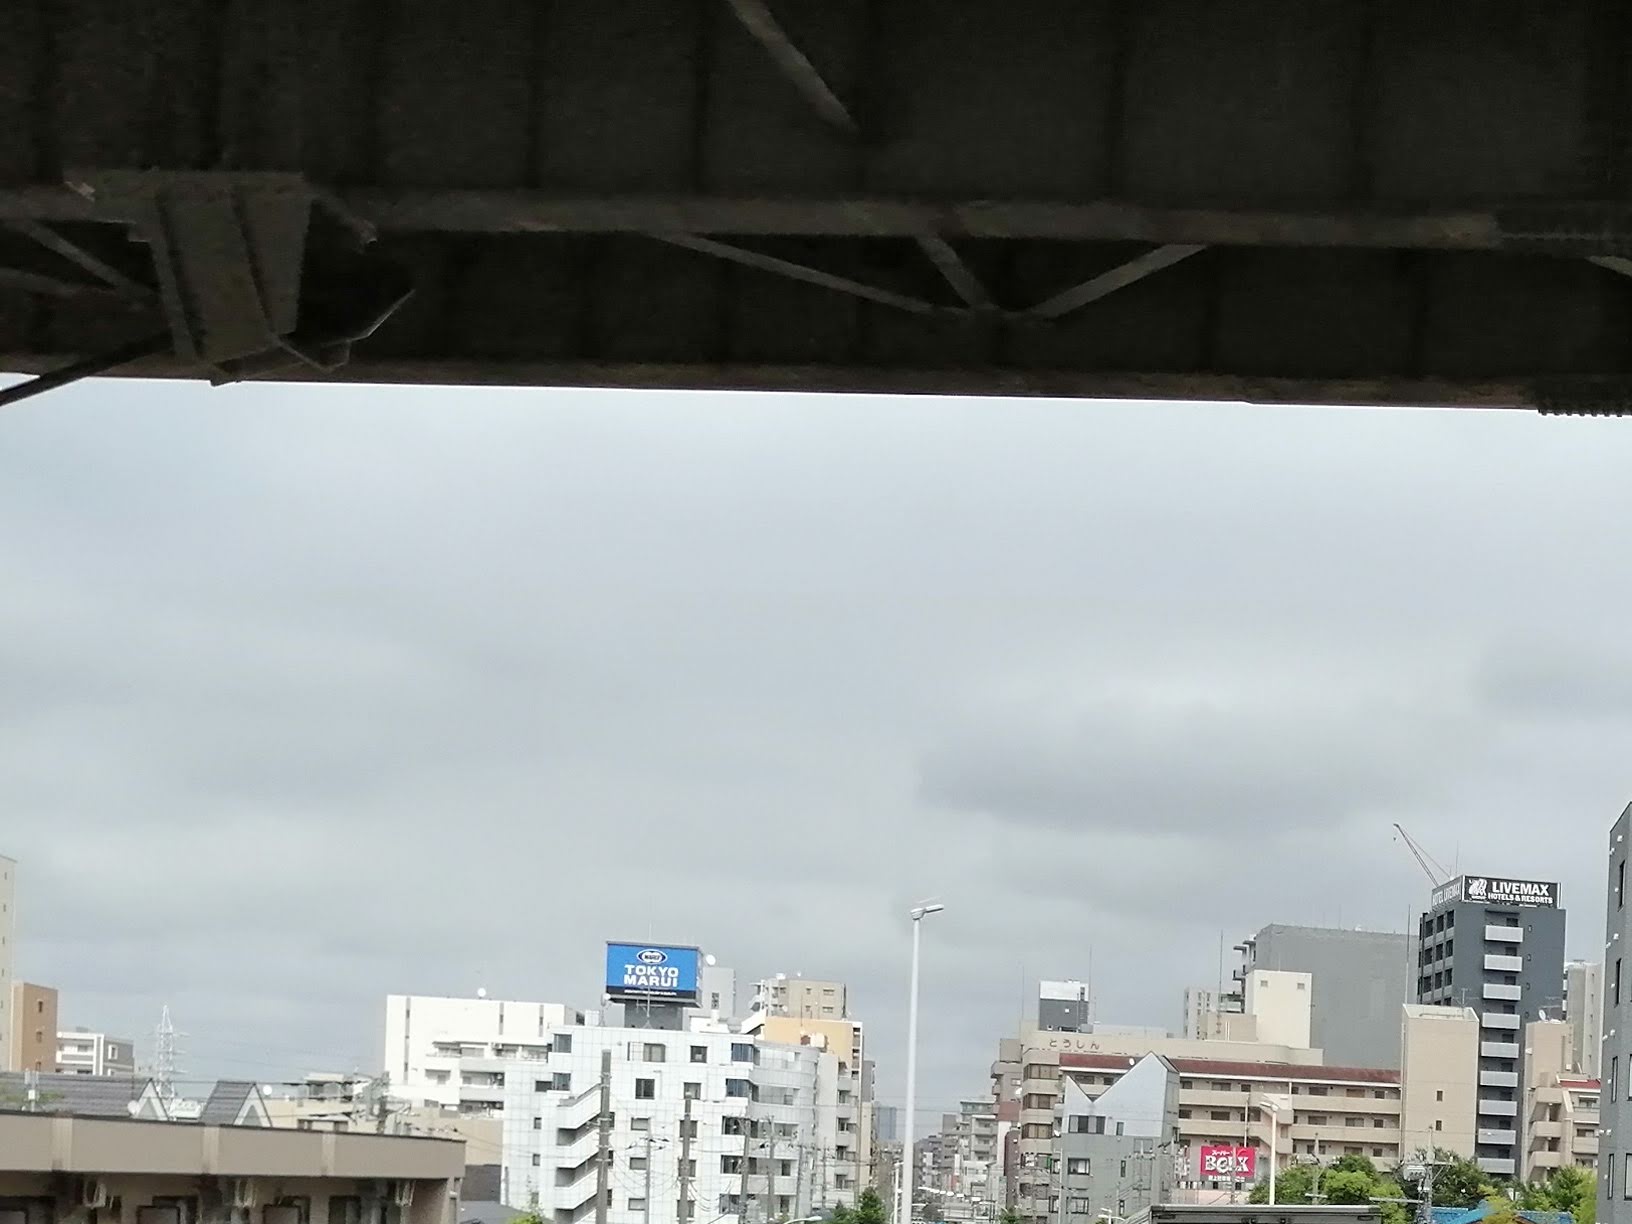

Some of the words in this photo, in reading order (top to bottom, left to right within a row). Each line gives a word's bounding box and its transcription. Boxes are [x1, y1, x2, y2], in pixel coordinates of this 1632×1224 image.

[1491, 881, 1550, 896] LIVEMAX
[1488, 892, 1515, 901] HOTELS
[1521, 895, 1553, 904] RESORTS
[624, 964, 679, 978] TOKYO
[623, 975, 678, 987] MARUI
